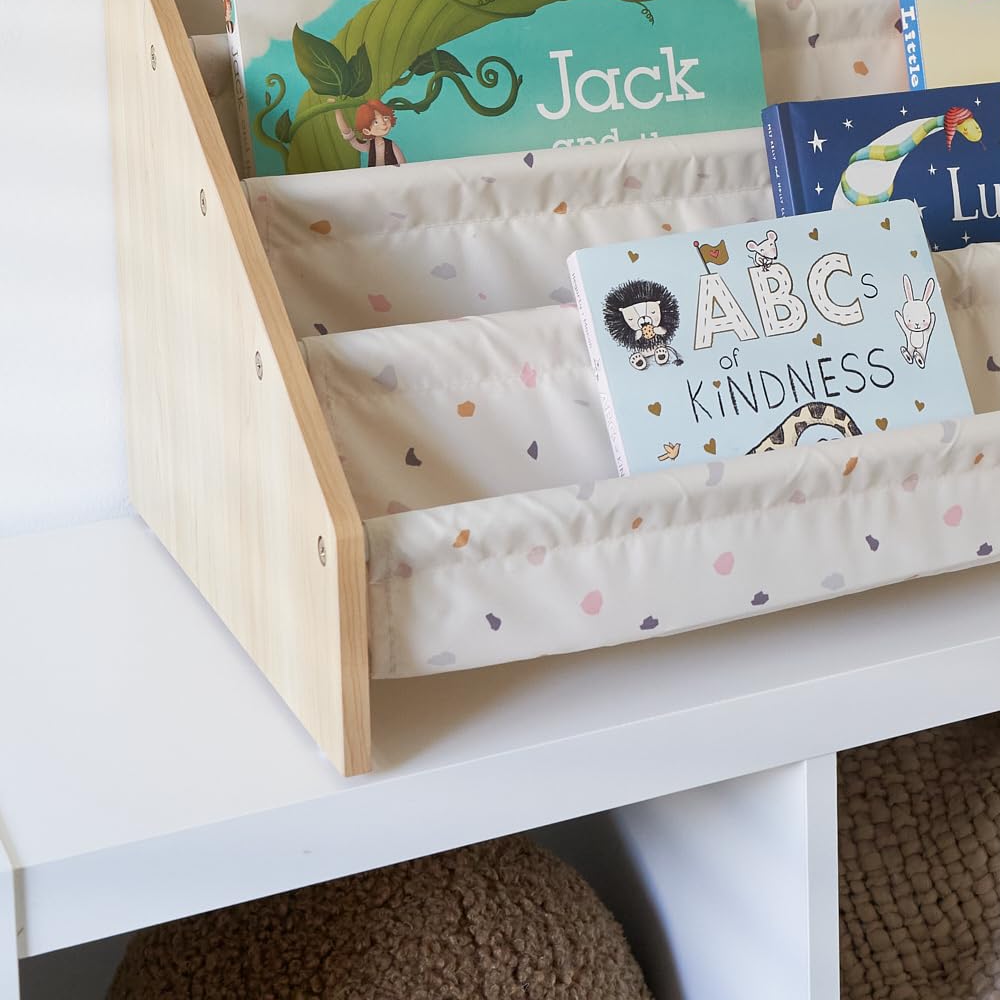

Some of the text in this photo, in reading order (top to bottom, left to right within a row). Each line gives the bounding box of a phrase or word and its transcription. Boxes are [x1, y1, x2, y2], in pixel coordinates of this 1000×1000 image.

[536, 46, 705, 120] Jack
[901, 6, 920, 88] Little
[718, 346, 740, 371] of
